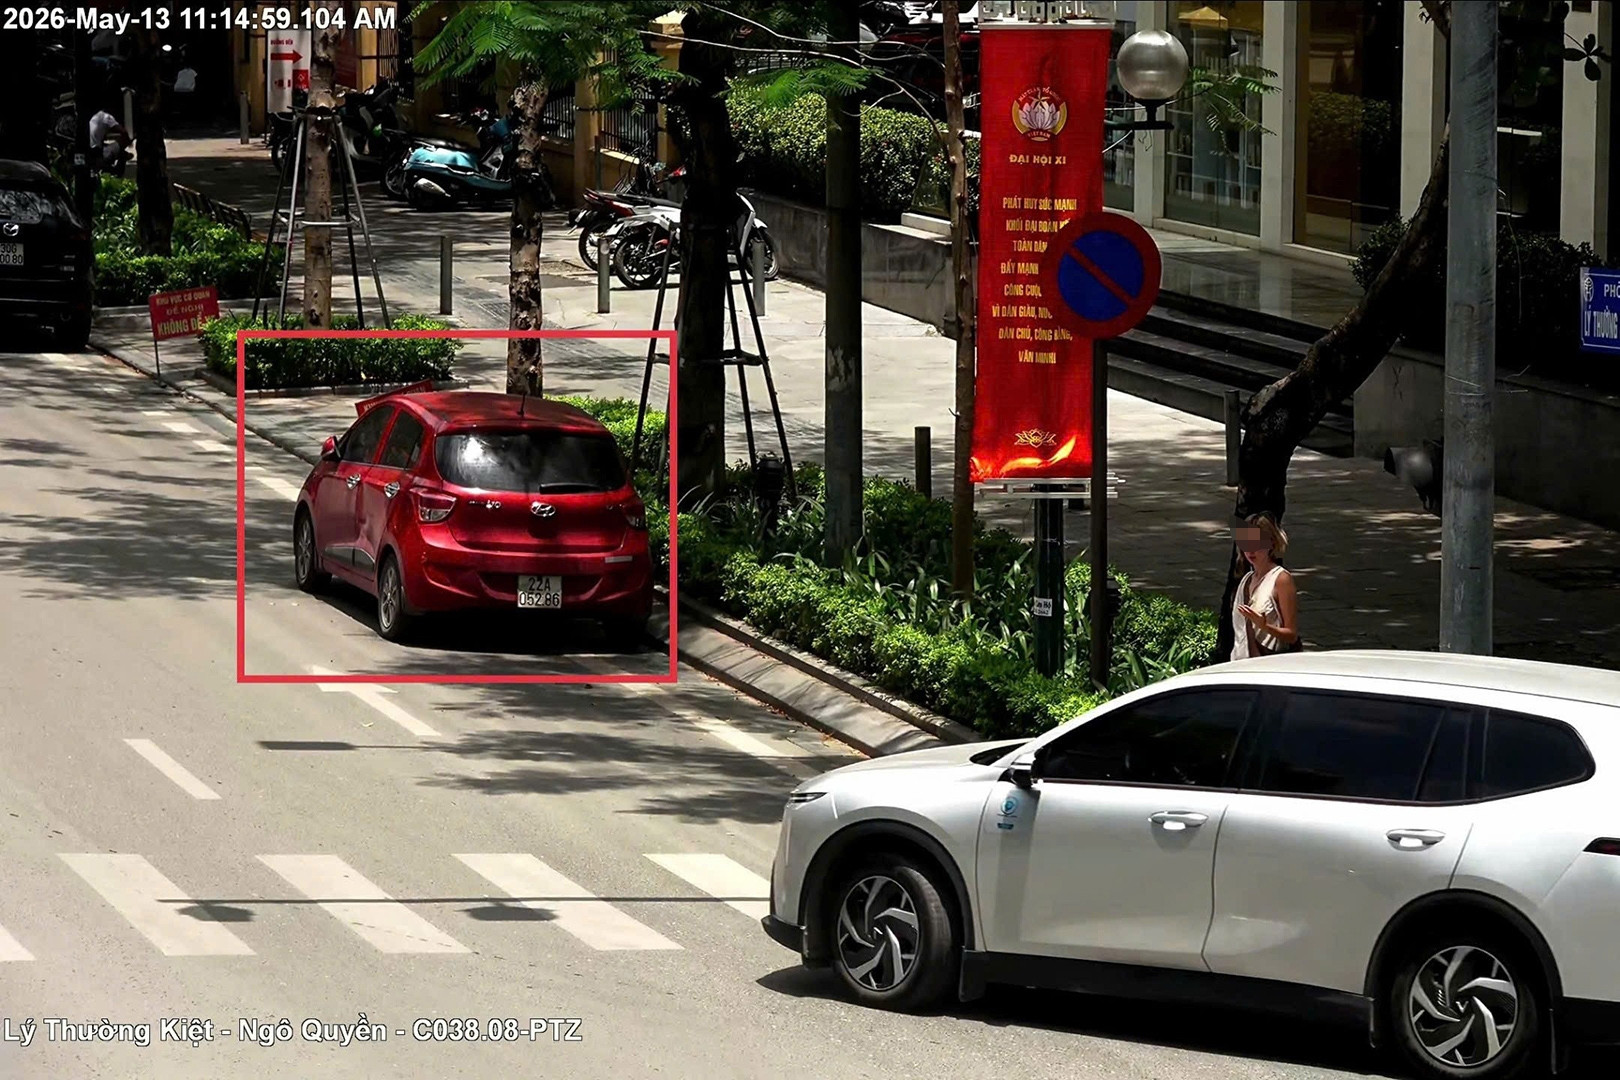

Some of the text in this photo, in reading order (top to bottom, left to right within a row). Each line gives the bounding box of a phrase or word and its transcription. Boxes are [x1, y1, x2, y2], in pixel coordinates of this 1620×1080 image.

[1009, 154, 1067, 166] ĐẠI HỘI XI
[1002, 195, 1022, 209] PHÁT
[1024, 197, 1038, 210] HUY
[1054, 198, 1077, 212] MẠNH
[1025, 219, 1037, 233] ĐẠI
[1013, 237, 1033, 252] TOÀN
[1017, 262, 1039, 276] MẠNH
[1004, 283, 1024, 297] CÔNG
[992, 303, 1000, 318] VÌ
[1001, 304, 1017, 318] DÂN
[157, 318, 189, 336] KHÔNG
[999, 326, 1015, 340] DÂN
[1034, 327, 1053, 341] CÔNG
[1018, 349, 1034, 363] VĂN
[528, 577, 551, 591] 22A
[519, 591, 560, 607] 052.86
